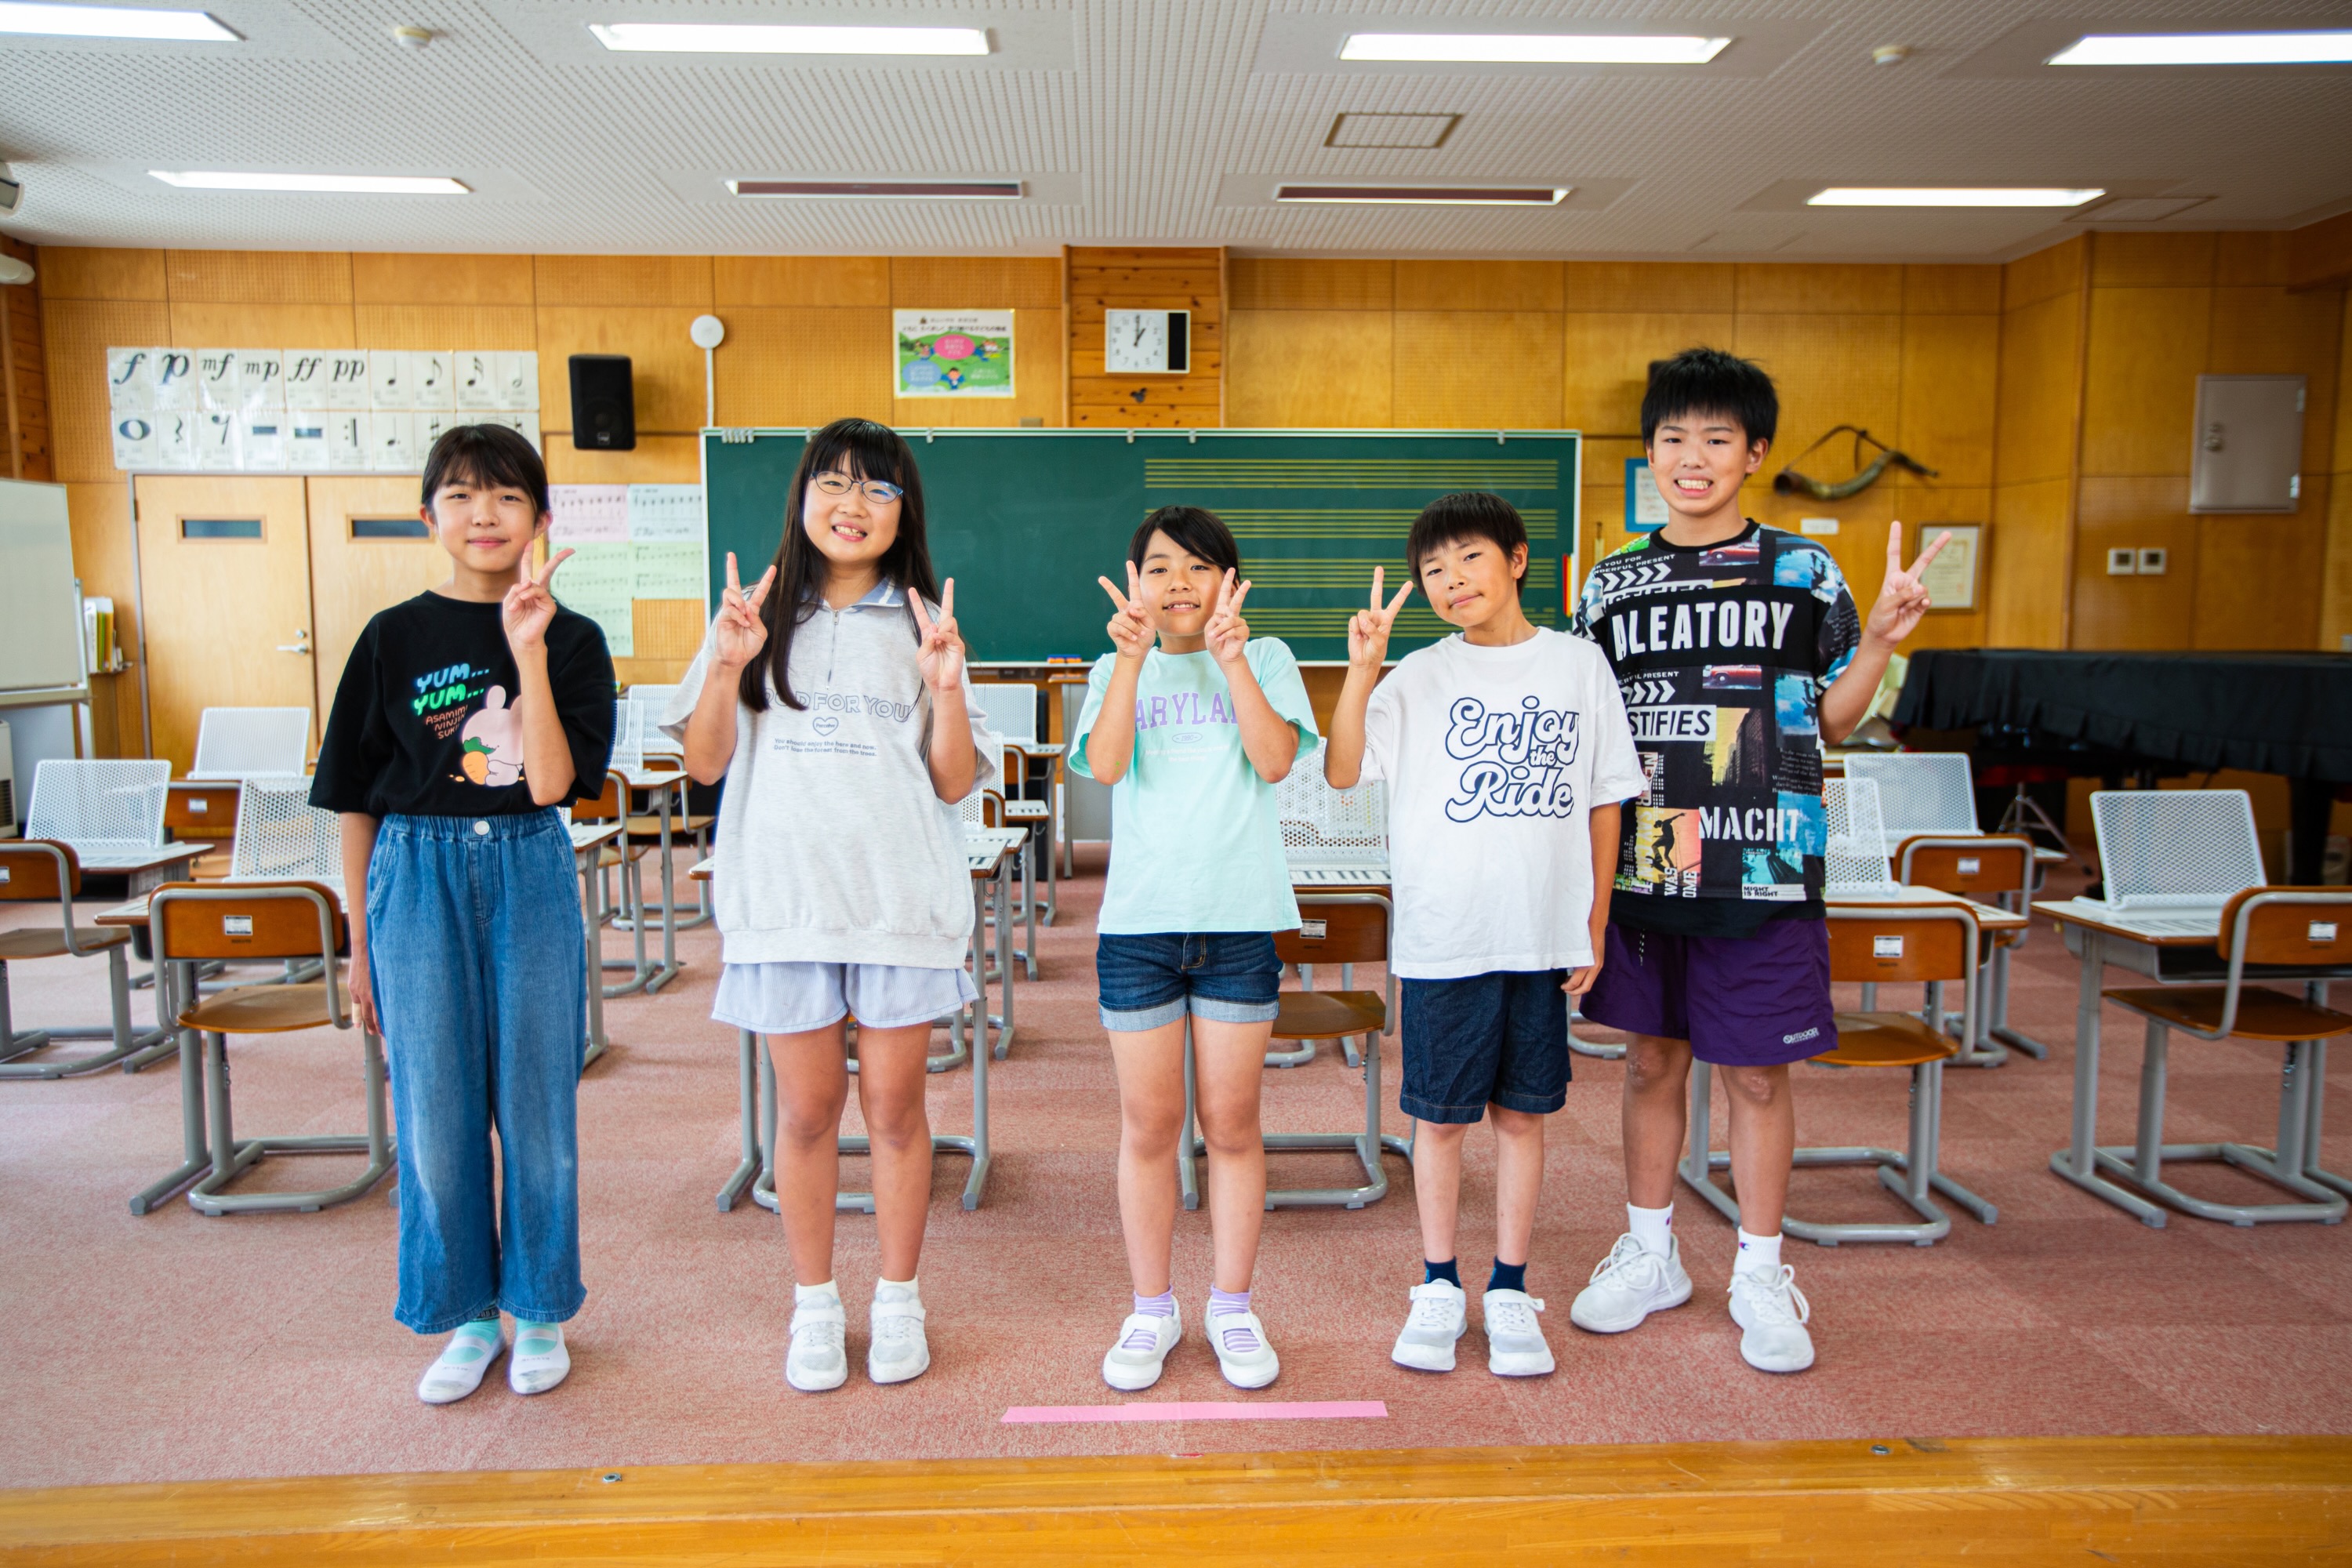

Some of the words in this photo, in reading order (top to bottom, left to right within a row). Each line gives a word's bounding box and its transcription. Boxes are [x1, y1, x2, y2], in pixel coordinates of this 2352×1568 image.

[1594, 564, 1634, 575] NDERFUL
[1636, 554, 1675, 566] PRESENT
[1611, 600, 1795, 662] ALEATORY
[812, 691, 861, 713] FOR
[863, 695, 911, 723] YOU
[1134, 691, 1238, 731] ARYLA
[1627, 710, 1711, 736] STIFIES
[1445, 695, 1580, 766] Enjoy
[1529, 745, 1558, 767] the
[1445, 760, 1574, 823] Ride
[1635, 754, 1656, 808] NER
[1664, 866, 1679, 896] WAS
